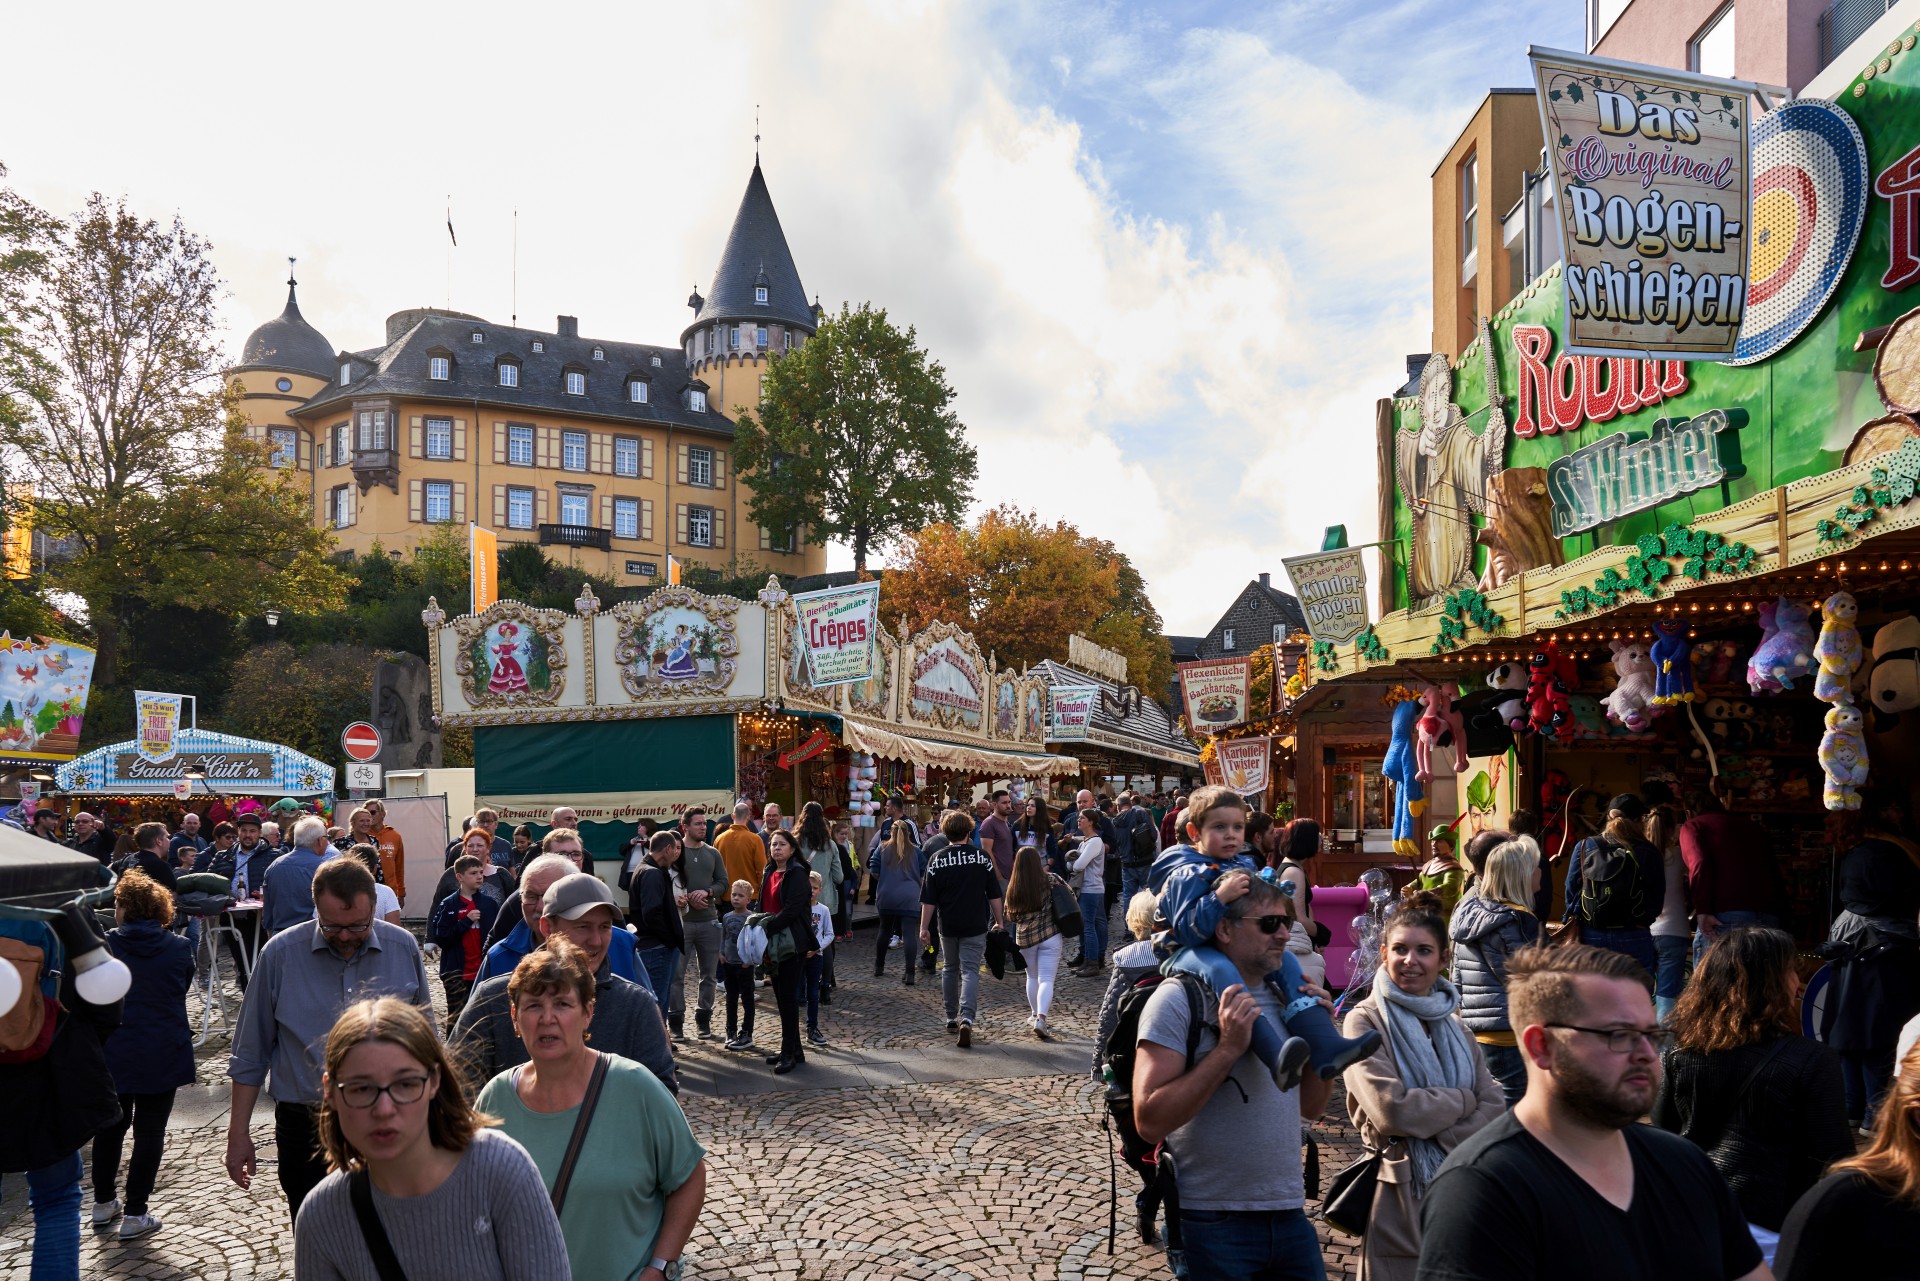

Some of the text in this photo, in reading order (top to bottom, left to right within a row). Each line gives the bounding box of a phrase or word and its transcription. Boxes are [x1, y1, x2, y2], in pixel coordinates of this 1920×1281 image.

[1594, 89, 1701, 144] Das
[1565, 134, 1734, 189] Original
[1568, 184, 1743, 258] Bogen-
[479, 550, 488, 608] Eifelmuseum
[1301, 575, 1364, 604] Kinder-
[834, 598, 869, 615] Qualitäts-
[1307, 597, 1364, 625] Bögen
[1332, 620, 1339, 631] 6
[810, 617, 867, 650] Crêpes
[817, 655, 865, 668] herzhaft oder
[1185, 665, 1245, 679] Hexenküche
[153, 702, 159, 710] 5
[1056, 701, 1088, 713] Mandeln
[148, 715, 167, 728] FREIE
[1061, 713, 1085, 726] Nüsse
[1195, 723, 1210, 732] mal
[143, 728, 171, 742] AUSWAHL
[1224, 745, 1265, 760] Kartoffel-
[1228, 758, 1260, 771] Twister
[358, 779, 370, 787] frei
[612, 804, 667, 819] gebrannte
[670, 802, 726, 816] Mdeln
